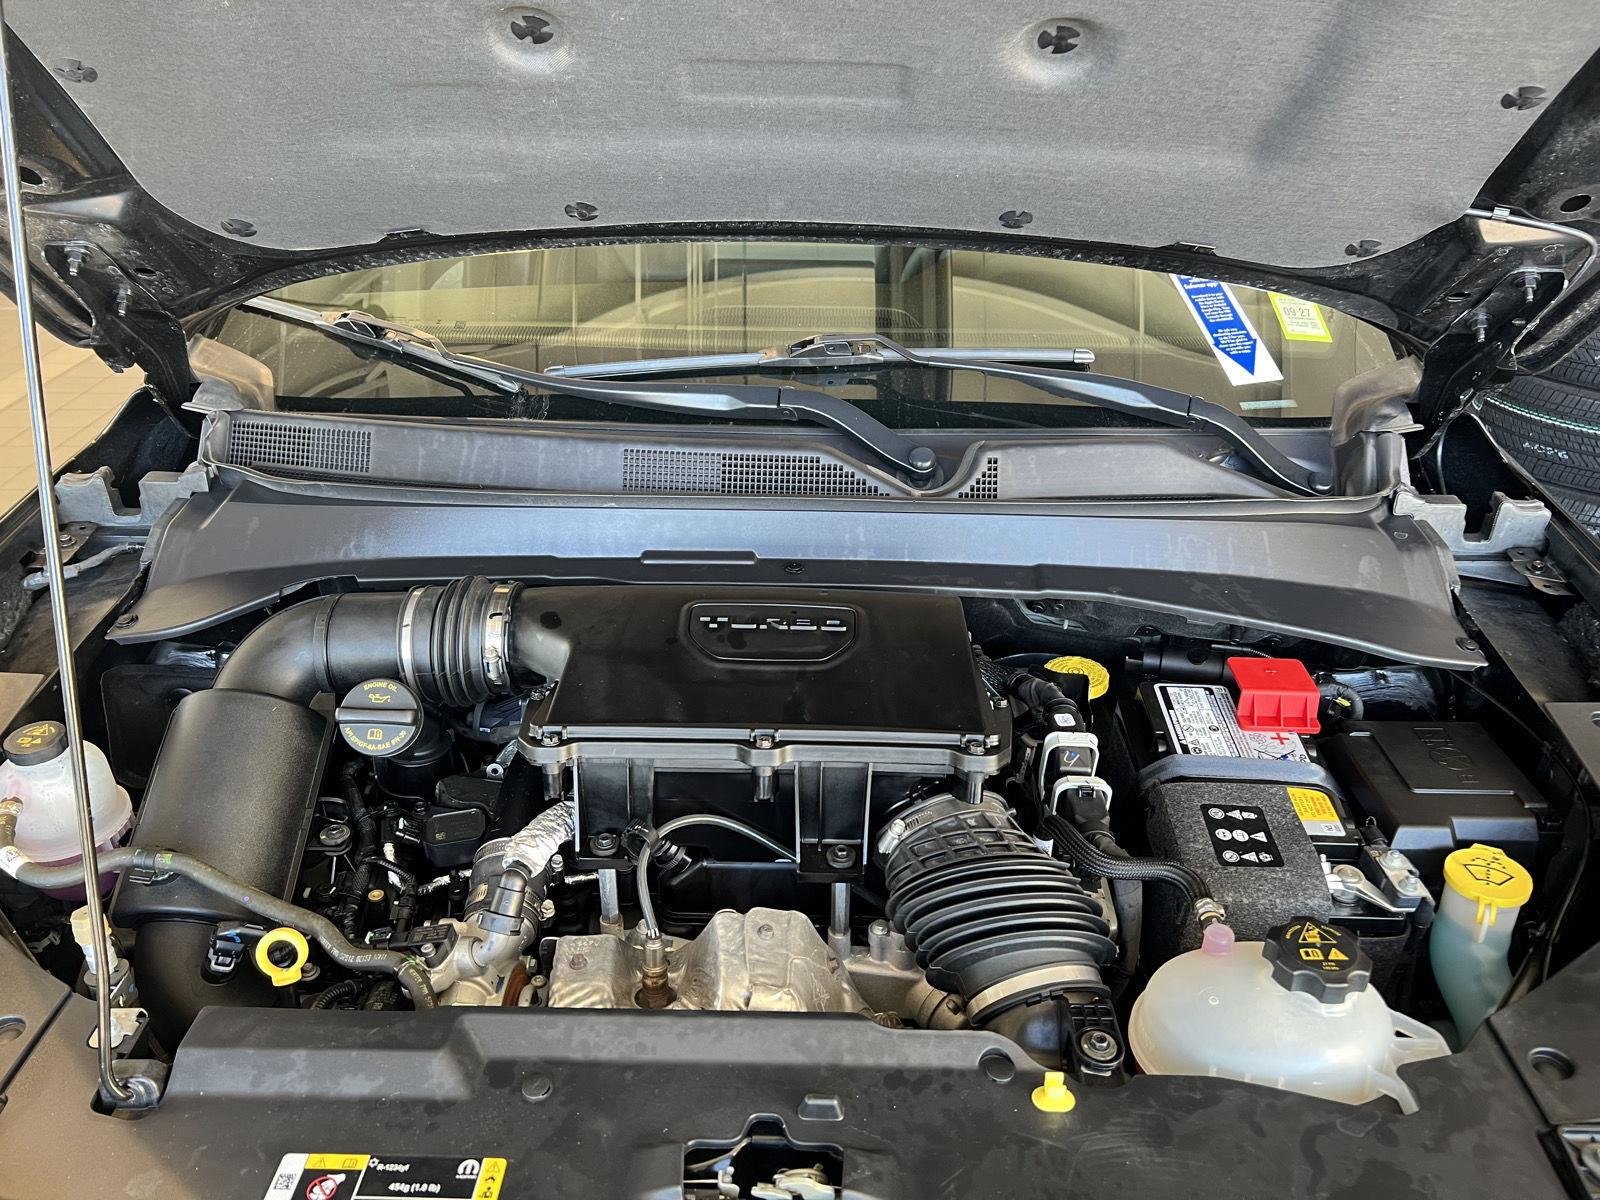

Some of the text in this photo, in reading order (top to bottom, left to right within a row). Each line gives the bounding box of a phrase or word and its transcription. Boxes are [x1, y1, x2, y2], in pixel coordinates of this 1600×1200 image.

[699, 616, 847, 632] TURBO
[363, 681, 398, 693] ENGINE OIL
[344, 727, 353, 738] API
[388, 1182, 441, 1194] 454g (1.0 lb)
